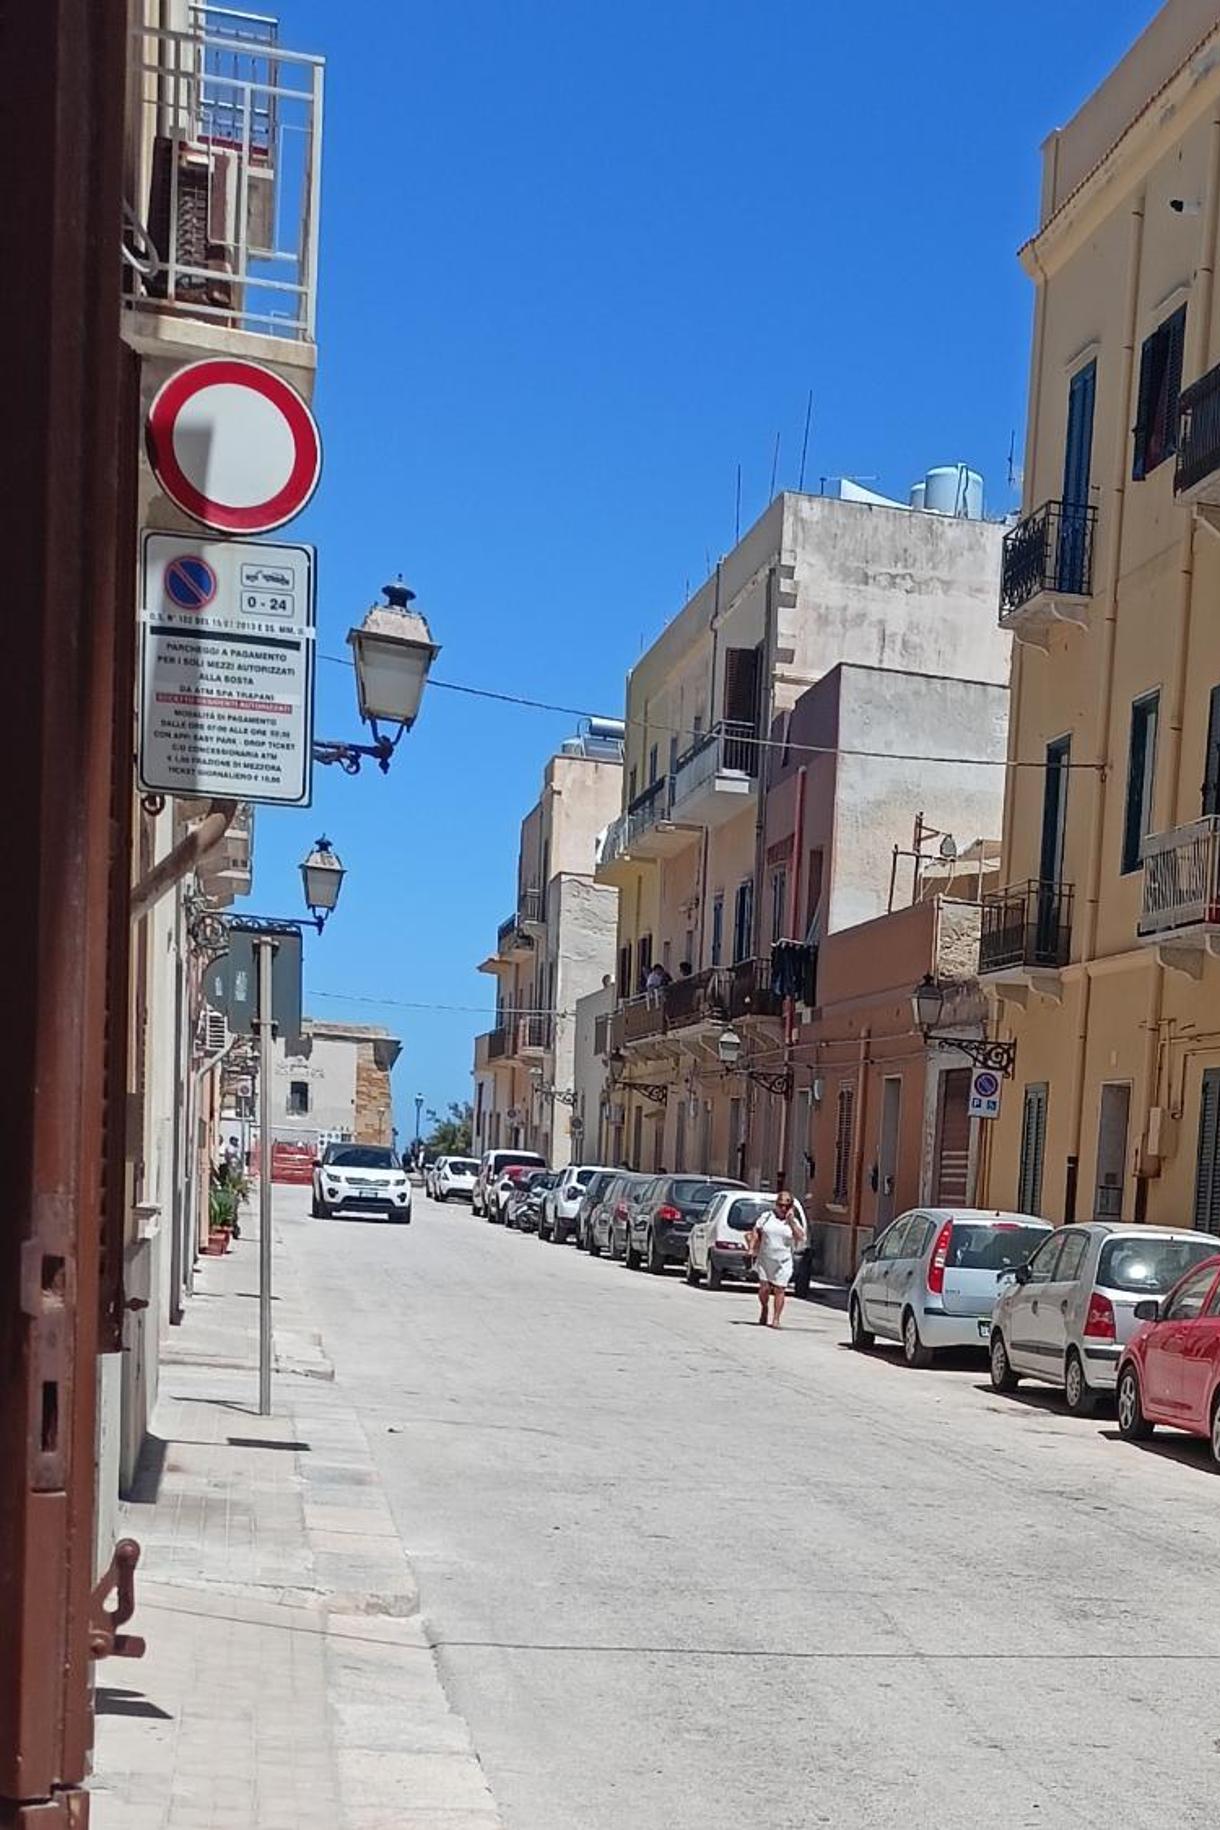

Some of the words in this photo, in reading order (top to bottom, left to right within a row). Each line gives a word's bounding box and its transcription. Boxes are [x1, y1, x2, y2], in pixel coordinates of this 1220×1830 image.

[248, 596, 256, 608] 0
[270, 598, 287, 611] 24
[166, 643, 219, 655] PARCHEGGI
[221, 648, 228, 657] A
[230, 649, 287, 662] PAGAMENTO
[157, 656, 177, 664] PER
[184, 657, 204, 667] SOLI
[207, 660, 235, 670] MEZZI
[237, 663, 296, 676] AUTORIZZATI
[199, 673, 221, 683] ALLA
[224, 675, 254, 685] SOSTA
[180, 685, 192, 693] DA
[195, 687, 214, 695] ATM
[216, 688, 233, 698] SPA
[236, 690, 274, 701] TRAPANI
[217, 712, 225, 720] DI
[227, 714, 277, 726] PAGAMENTO
[160, 719, 185, 728] DALLE
[229, 726, 248, 735] ALLE
[216, 736, 236, 745] PARK
[244, 739, 266, 748] DROP
[268, 741, 295, 750] TICKET
[188, 745, 259, 758] CONCESSIONARIA
[261, 751, 277, 760] ATM
[191, 757, 231, 767] FRAZIONE
[232, 760, 241, 768] DI
[168, 766, 196, 775] TICKET
[197, 769, 253, 780] GIORNALIERO
